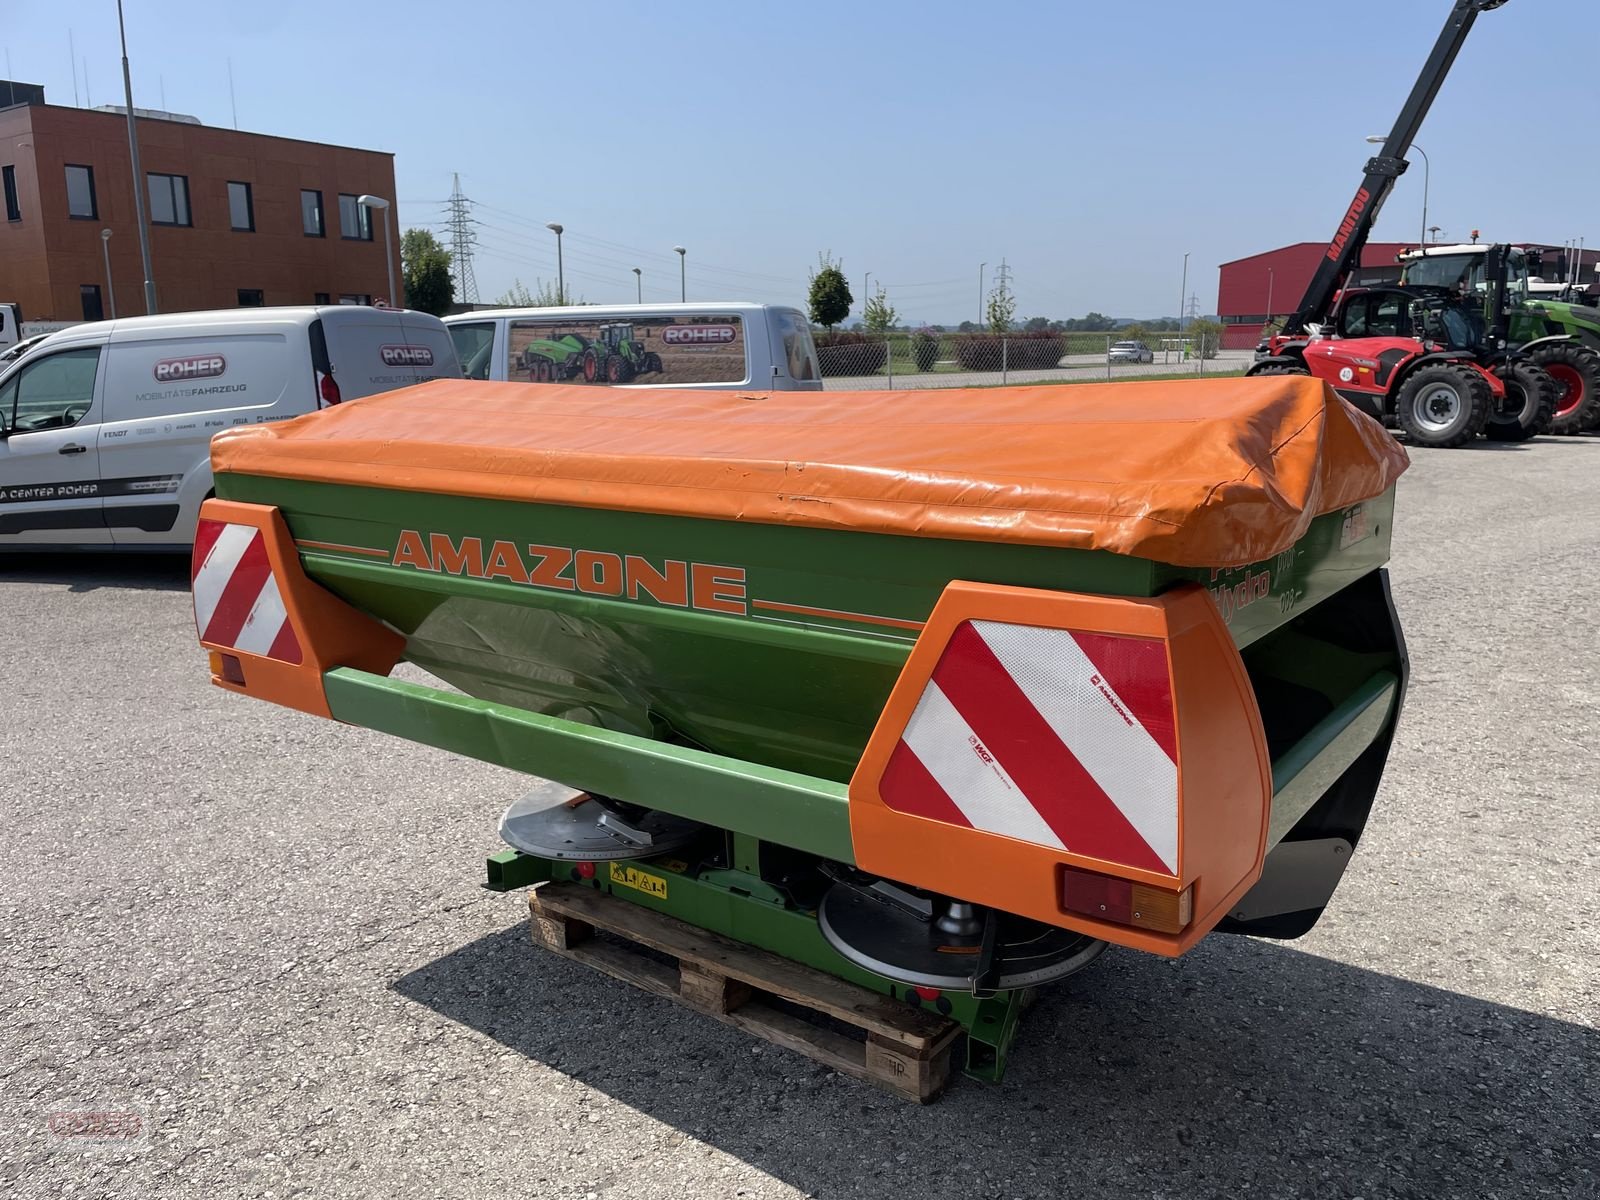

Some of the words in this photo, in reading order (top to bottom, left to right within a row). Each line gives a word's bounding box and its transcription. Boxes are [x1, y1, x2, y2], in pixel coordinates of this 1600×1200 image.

[1327, 187, 1370, 262] MANITOU
[665, 329, 733, 342] ROHER
[382, 348, 432, 363] ROHER
[157, 359, 223, 379] ROHER
[9, 488, 53, 499] CENTER
[58, 484, 98, 496] ROHER
[392, 529, 747, 616] AMAZONE
[1209, 570, 1270, 625] Hydro
[1099, 685, 1134, 727] AMAZONE
[975, 743, 994, 764] WGF
